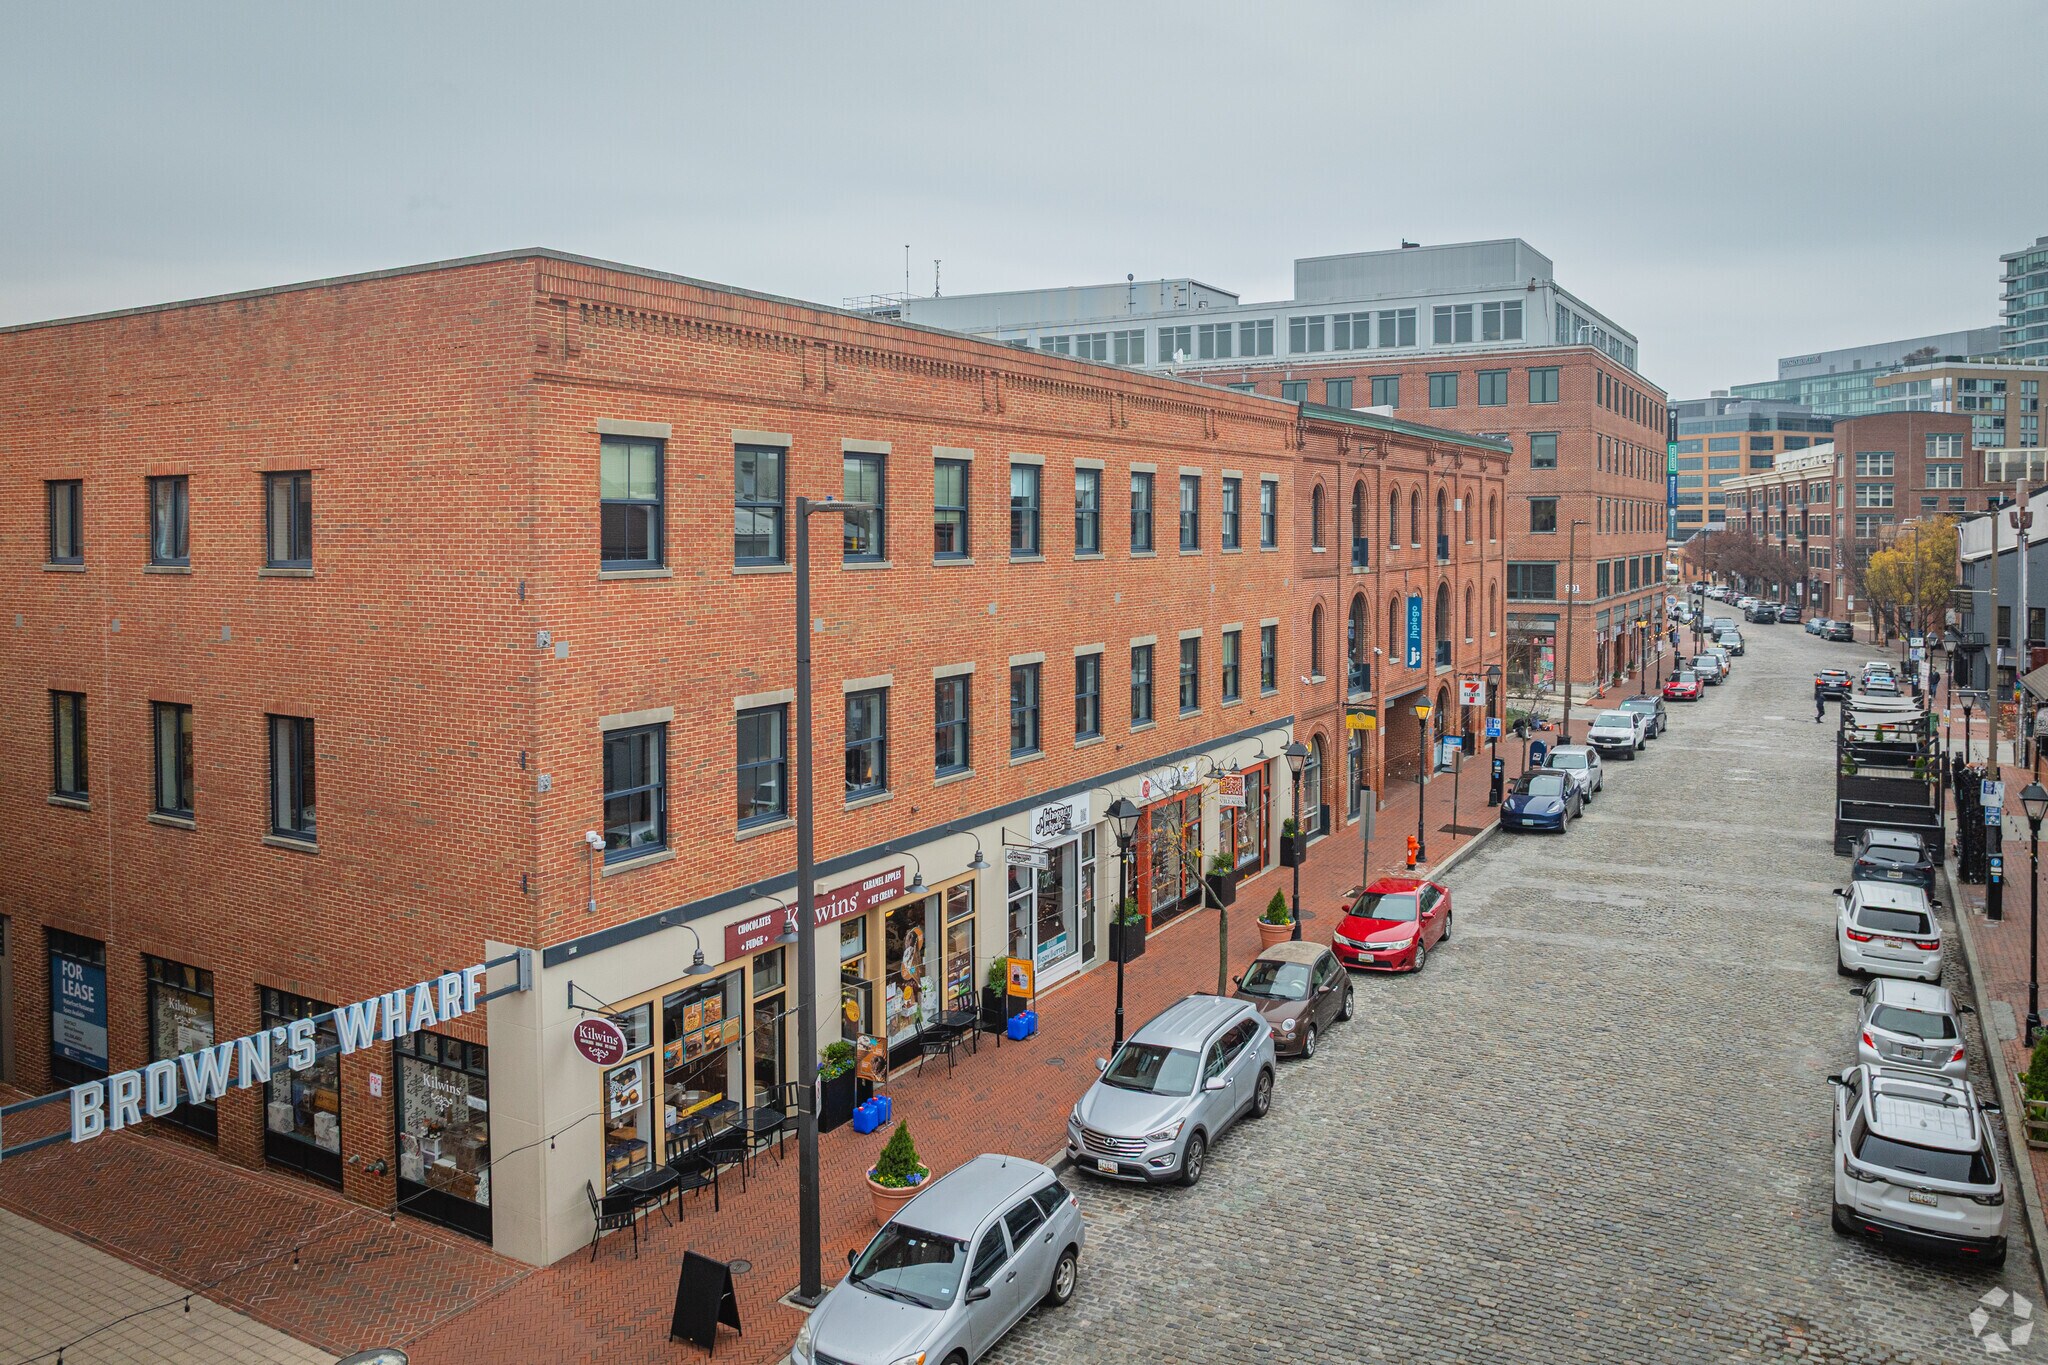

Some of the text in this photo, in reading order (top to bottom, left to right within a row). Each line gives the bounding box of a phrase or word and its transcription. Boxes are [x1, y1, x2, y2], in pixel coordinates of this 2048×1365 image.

[1410, 605, 1419, 639] jhpiego
[862, 870, 901, 891] CARAMEL APPLES
[871, 889, 894, 904] ICE CREAM
[785, 894, 858, 931] Kwins
[737, 914, 772, 935] CHOCOLATES
[745, 935, 764, 951] FUDGE
[62, 960, 83, 981] FOR
[62, 978, 95, 1003] LEASE
[169, 997, 198, 1015] Kilwins
[579, 1025, 619, 1045] Kilwins
[70, 964, 486, 1143] BROWN'S WHARF
[422, 1073, 462, 1096] Kilwins
